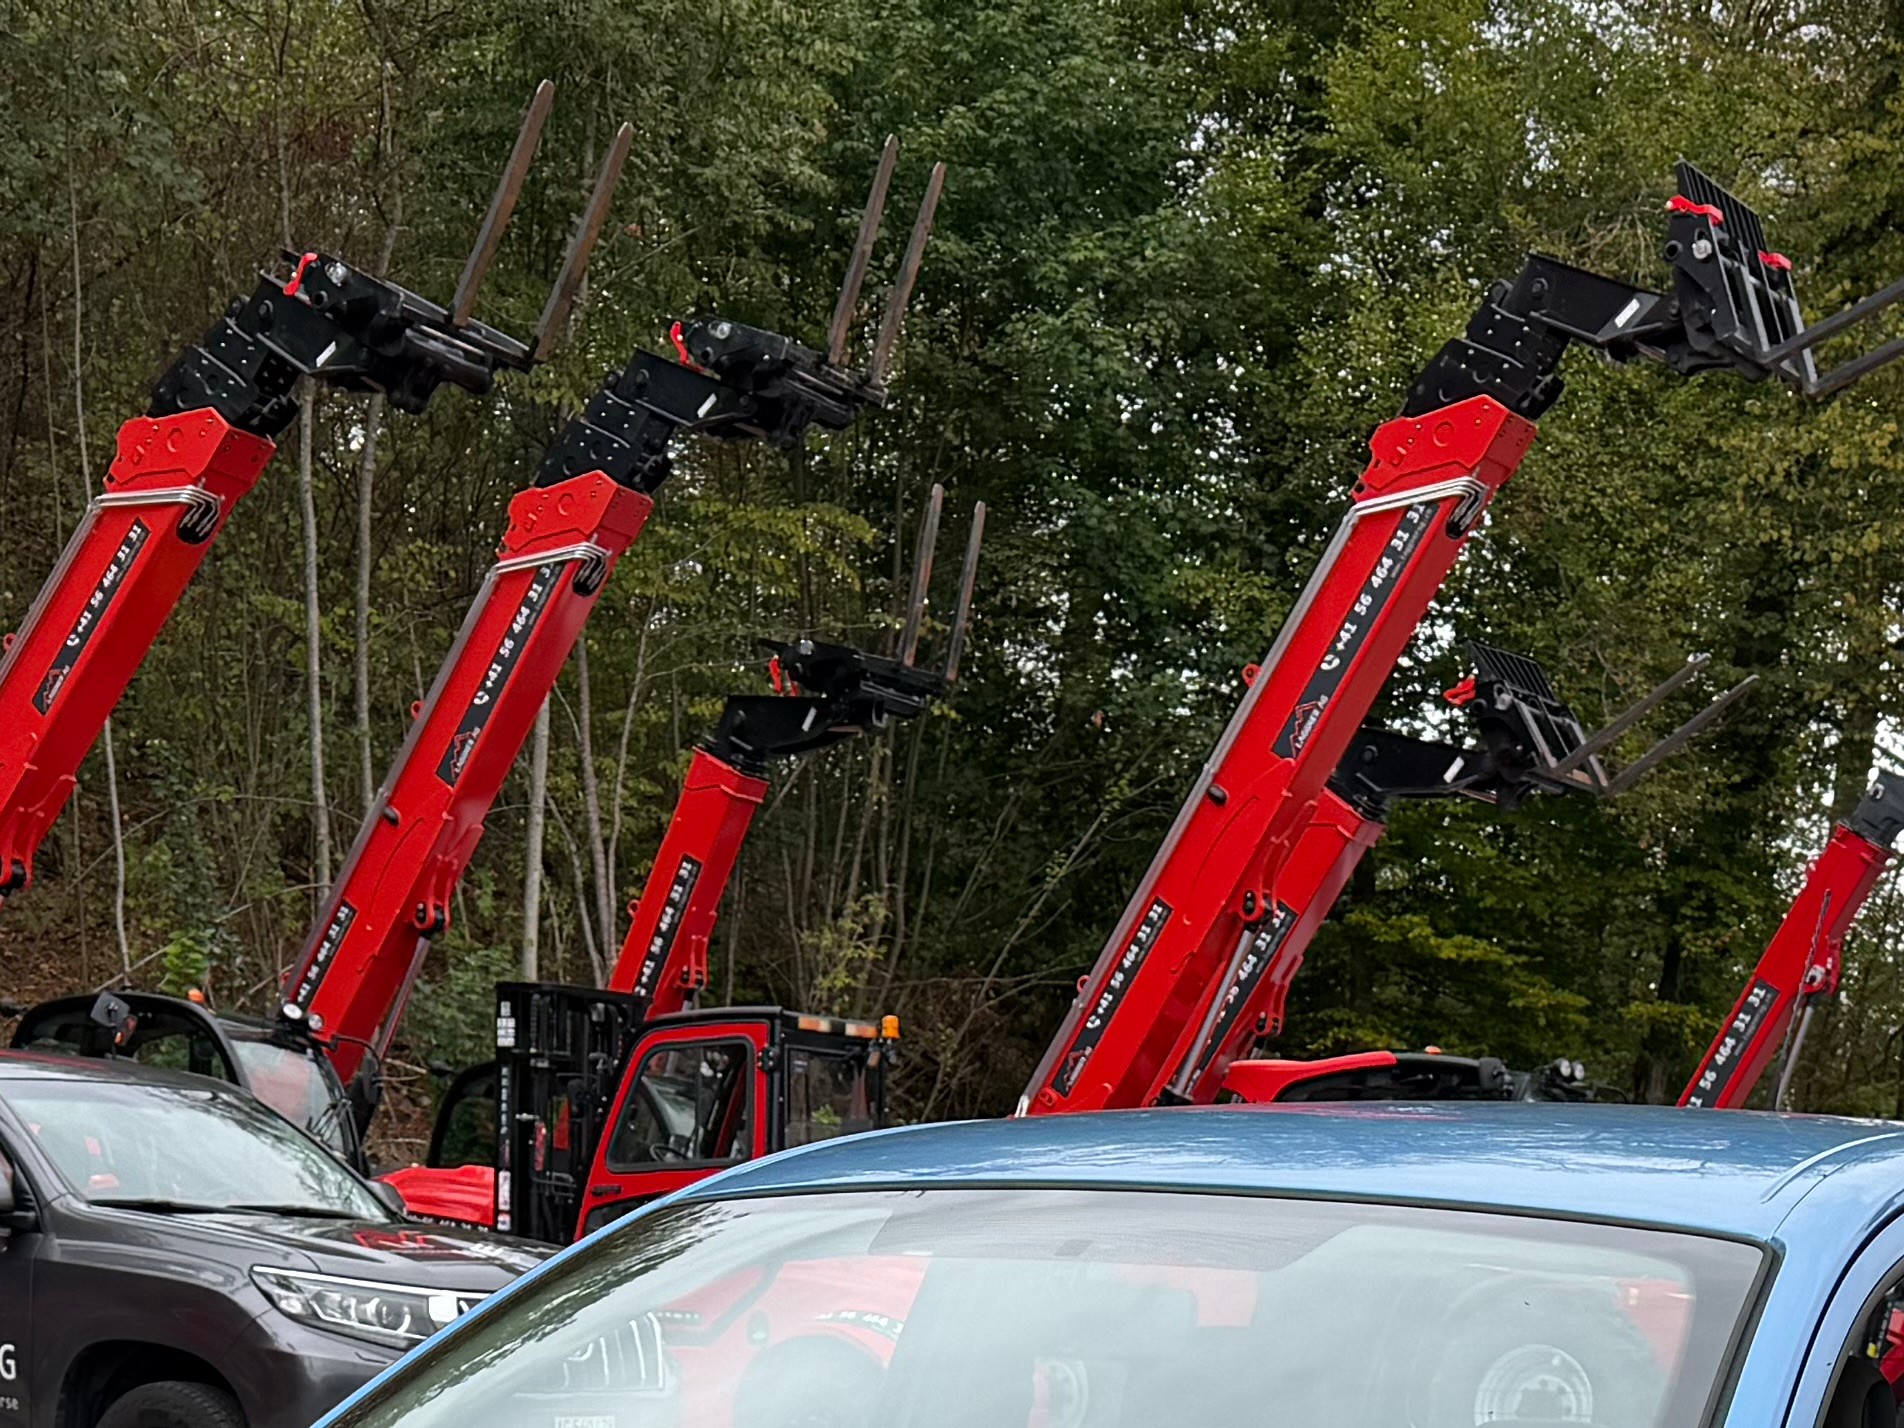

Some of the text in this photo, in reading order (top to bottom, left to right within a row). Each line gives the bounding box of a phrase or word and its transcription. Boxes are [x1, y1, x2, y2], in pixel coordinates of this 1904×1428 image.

[498, 637, 515, 658] 56
[512, 605, 531, 634] 464
[527, 583, 544, 602] 31
[1336, 621, 1358, 651] +41
[1353, 592, 1373, 616] 56
[1370, 556, 1393, 588] 464
[1390, 529, 1410, 551] 31
[1698, 1069, 1717, 1092] 56
[1714, 1036, 1737, 1066] 464
[1732, 1012, 1752, 1034] 31
[1747, 986, 1767, 1008] 31
